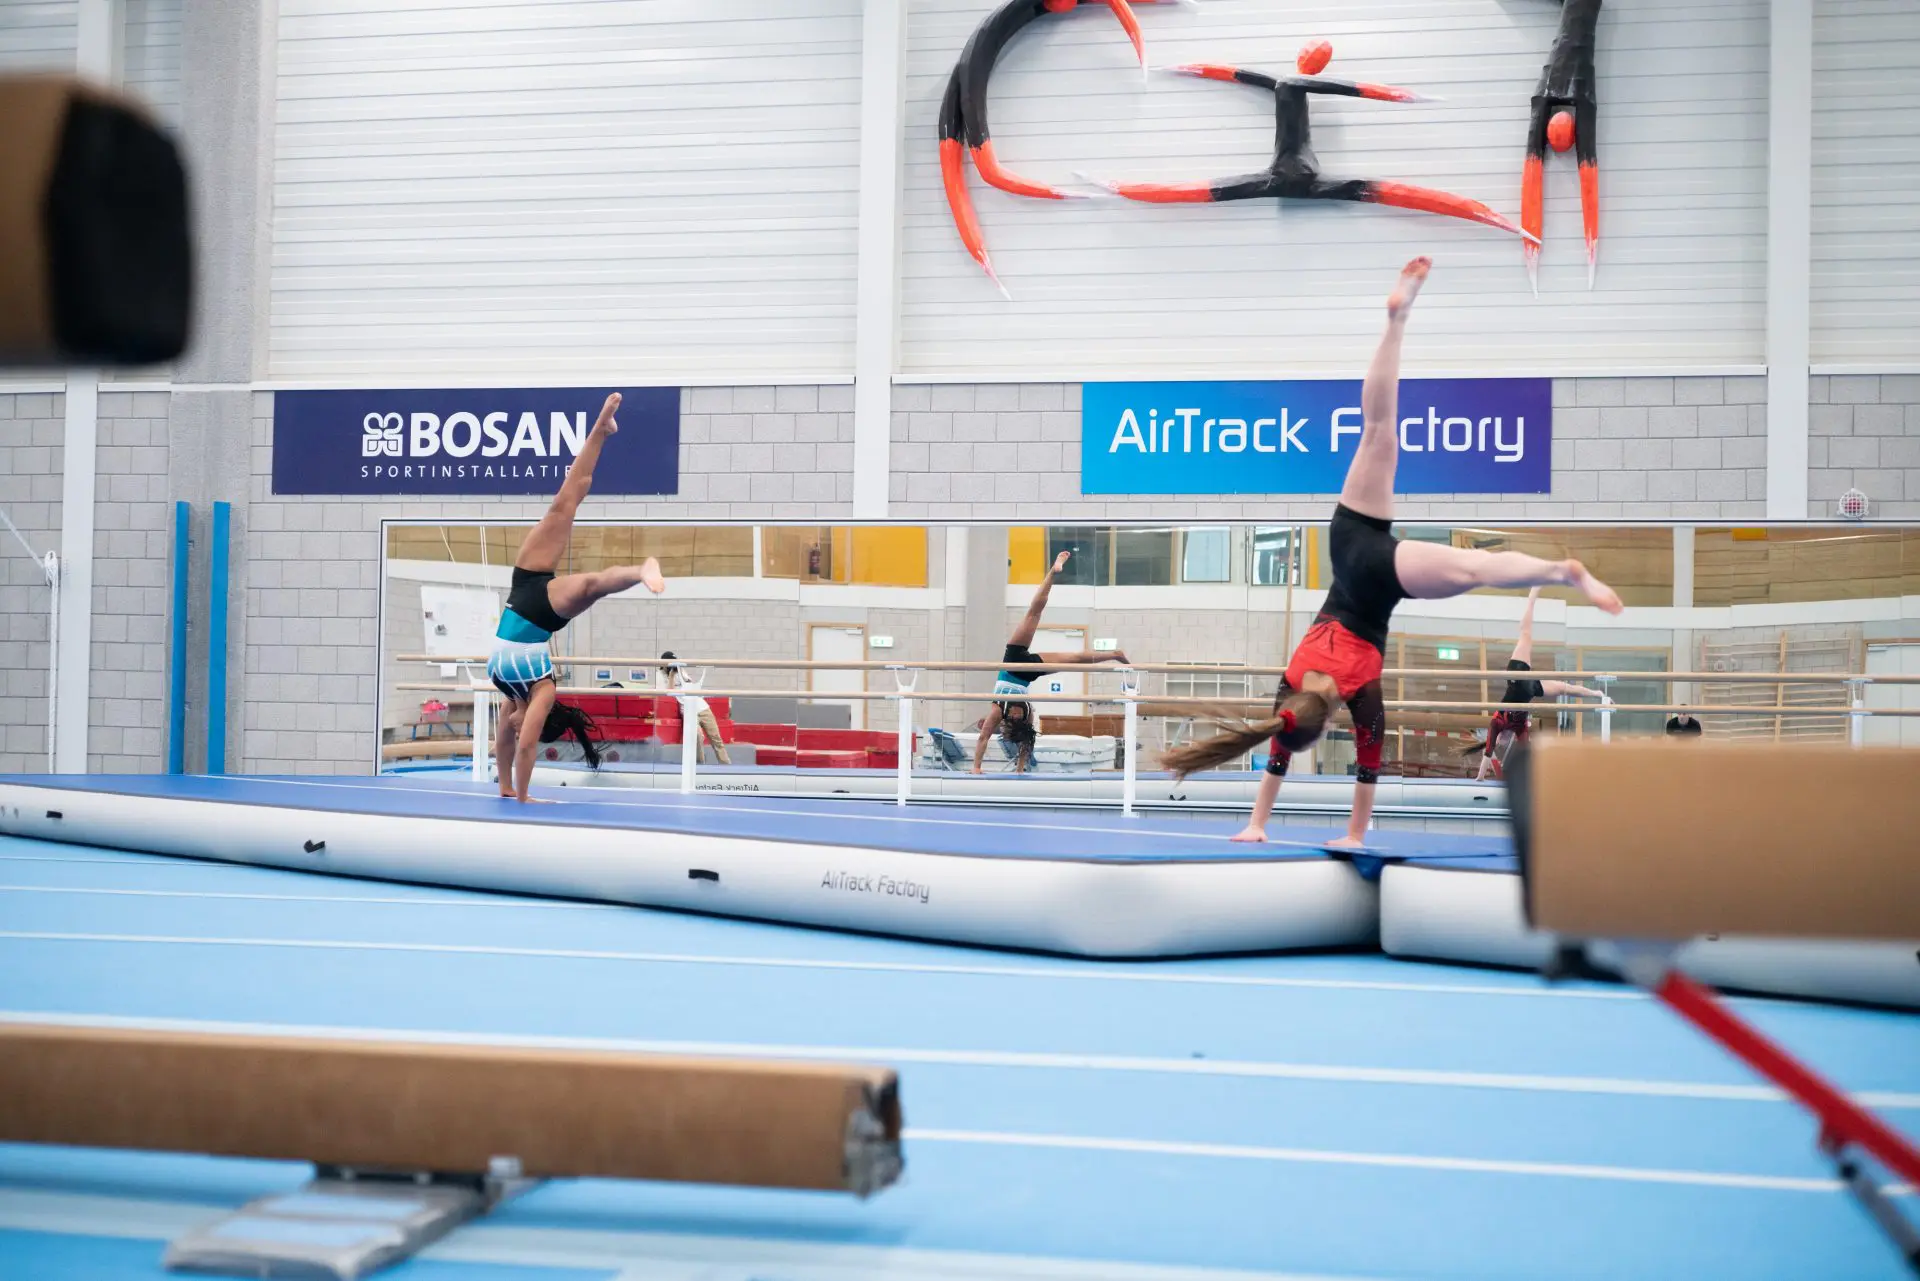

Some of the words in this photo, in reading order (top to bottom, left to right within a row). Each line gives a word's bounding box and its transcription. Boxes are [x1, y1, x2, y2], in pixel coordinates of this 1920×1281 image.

[410, 411, 587, 457] BOSAN
[1108, 407, 1309, 453] AirTrack
[1330, 407, 1524, 462] Fctory
[821, 869, 873, 892] AirTrack
[877, 873, 930, 904] Factory
